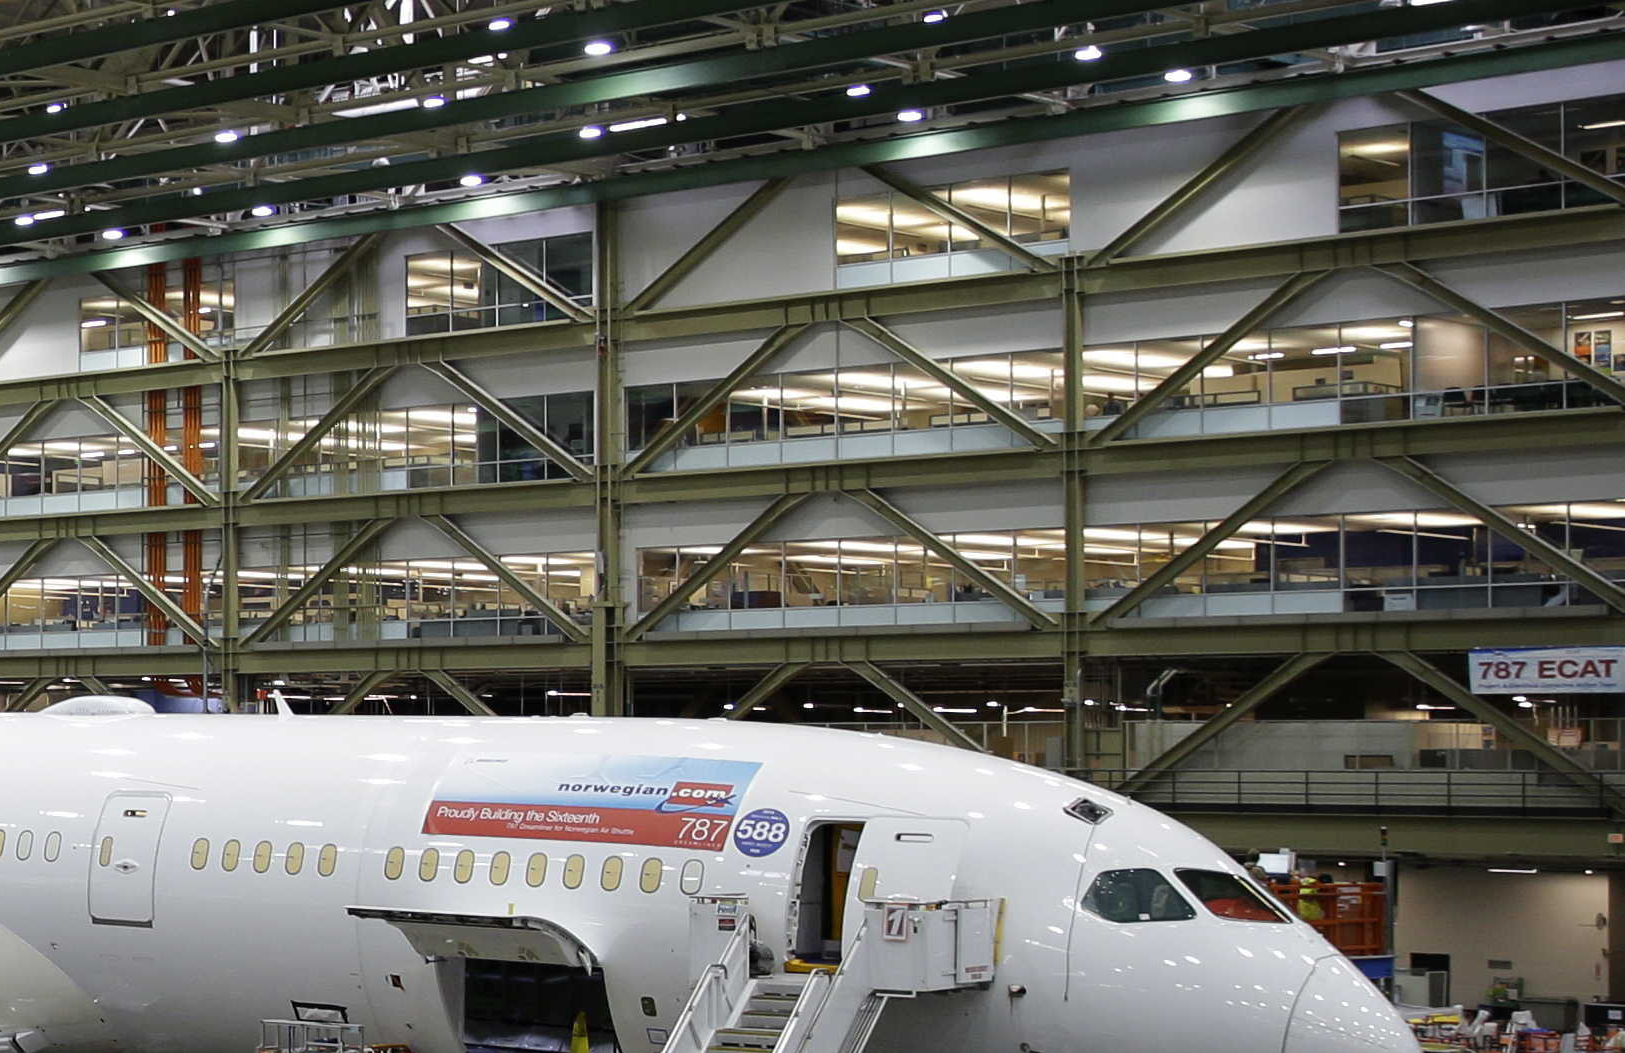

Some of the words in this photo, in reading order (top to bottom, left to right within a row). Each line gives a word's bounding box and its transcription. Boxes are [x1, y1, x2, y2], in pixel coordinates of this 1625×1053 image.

[1478, 661, 1527, 680] 787
[1538, 659, 1618, 679] ECAT
[437, 806, 480, 821] Proudly
[480, 807, 524, 823] Building
[526, 810, 544, 822] the
[546, 811, 601, 824] Sixteenth
[564, 825, 598, 834] Norwegian
[679, 817, 728, 841] 787
[736, 820, 786, 842] 588
[887, 909, 905, 935] 1
